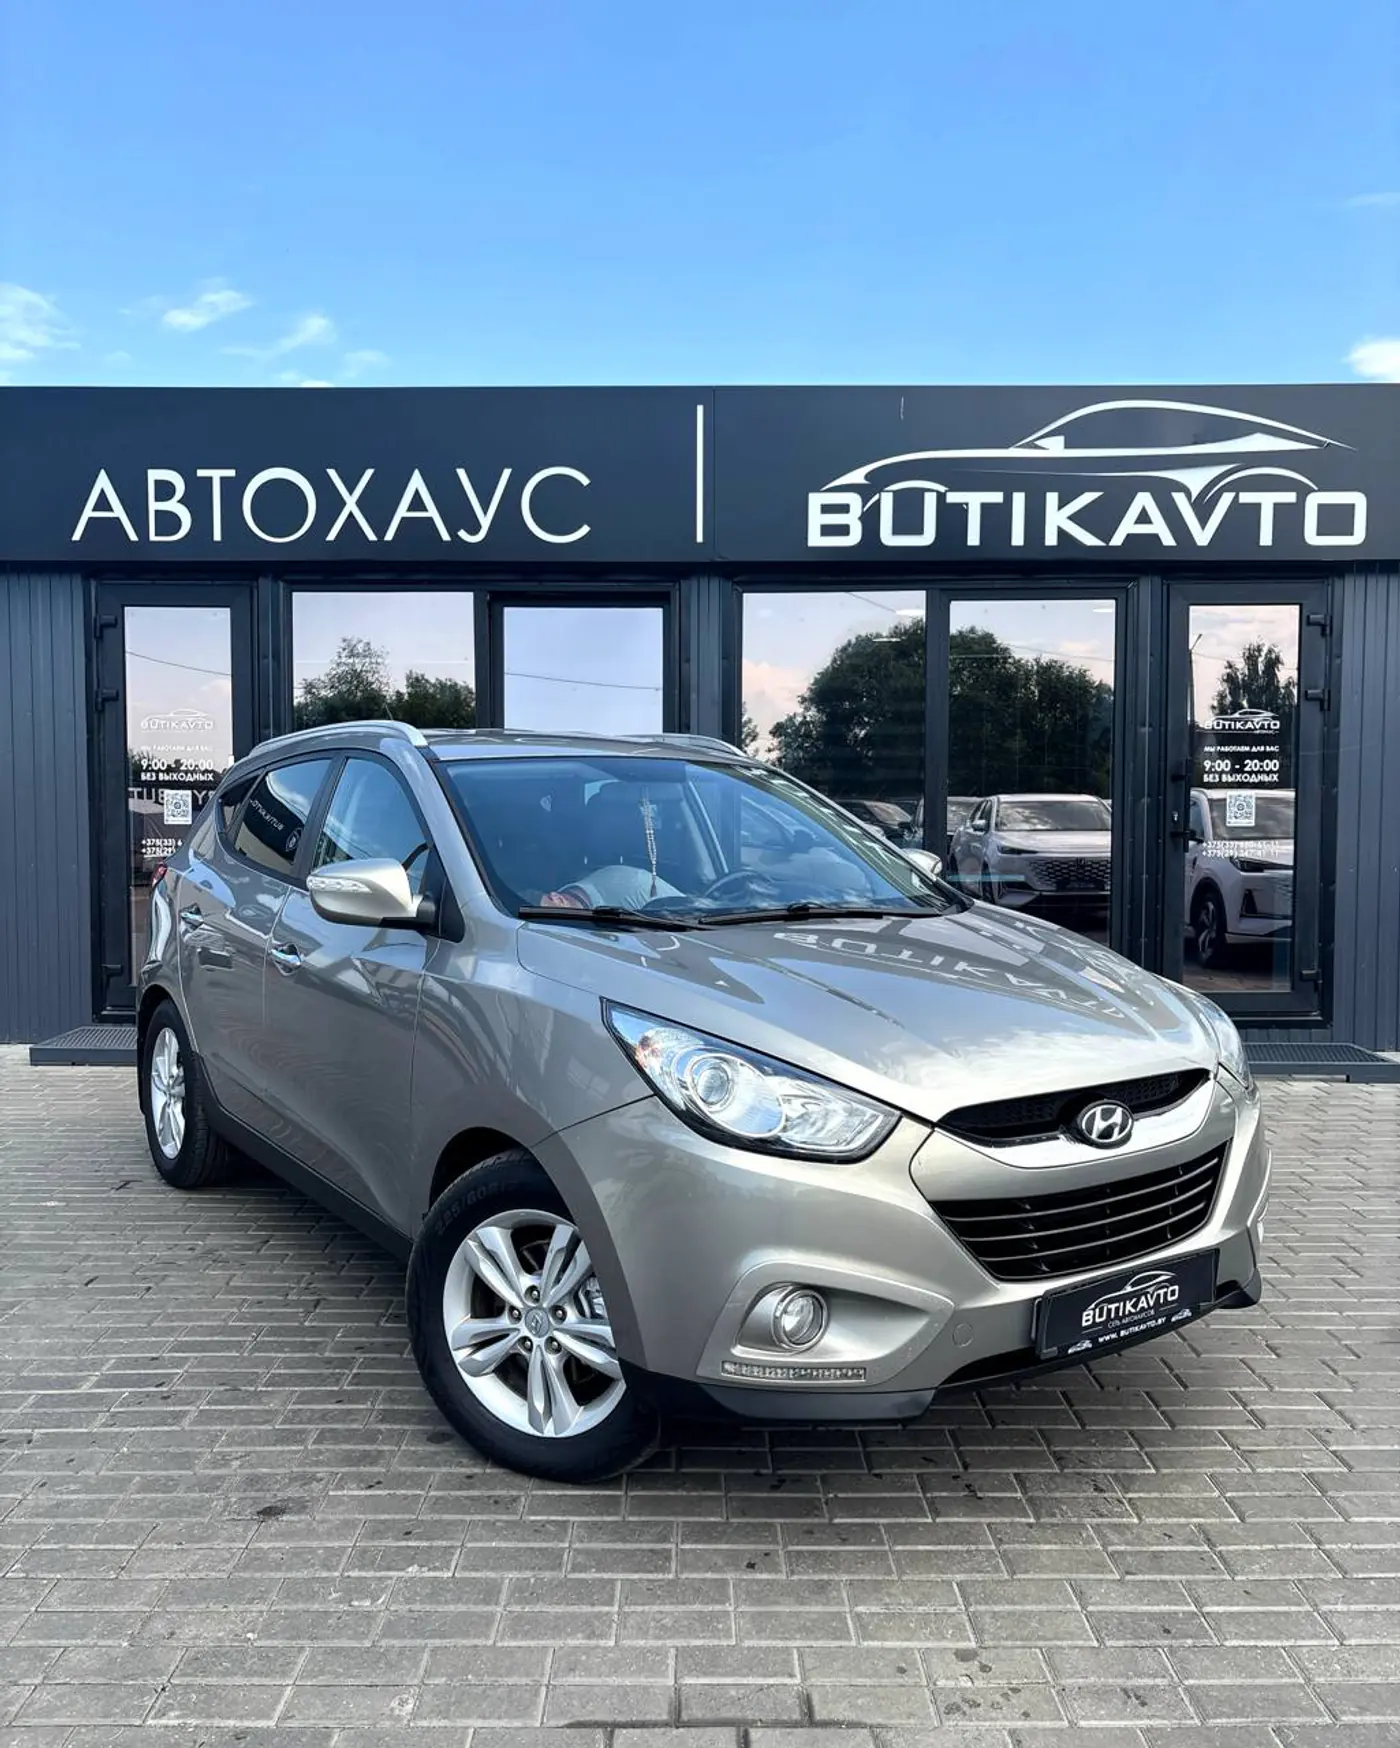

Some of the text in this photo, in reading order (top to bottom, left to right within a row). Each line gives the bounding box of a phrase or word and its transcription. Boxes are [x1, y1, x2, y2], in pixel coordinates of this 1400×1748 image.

[72, 466, 591, 545] АВТОХАУС
[808, 490, 1368, 548] BUTIKAVTO
[1204, 720, 1280, 730] BUTIKAVTO
[1251, 745, 1264, 753] ДЛЯ
[141, 758, 167, 770] 9:00
[179, 758, 214, 770] 20:00
[1203, 759, 1231, 772] 9:00
[1243, 759, 1280, 772] 20:00
[141, 771, 214, 782] БЕЗ ВЫХОДНЫХ
[1203, 773, 1280, 783] БЕЗ ВЫХОДНЫХ
[141, 838, 176, 847] +375(33)
[1081, 1285, 1179, 1327] BUTIKAVTO
[1120, 1316, 1167, 1337] BUTIKAVTO.BY
